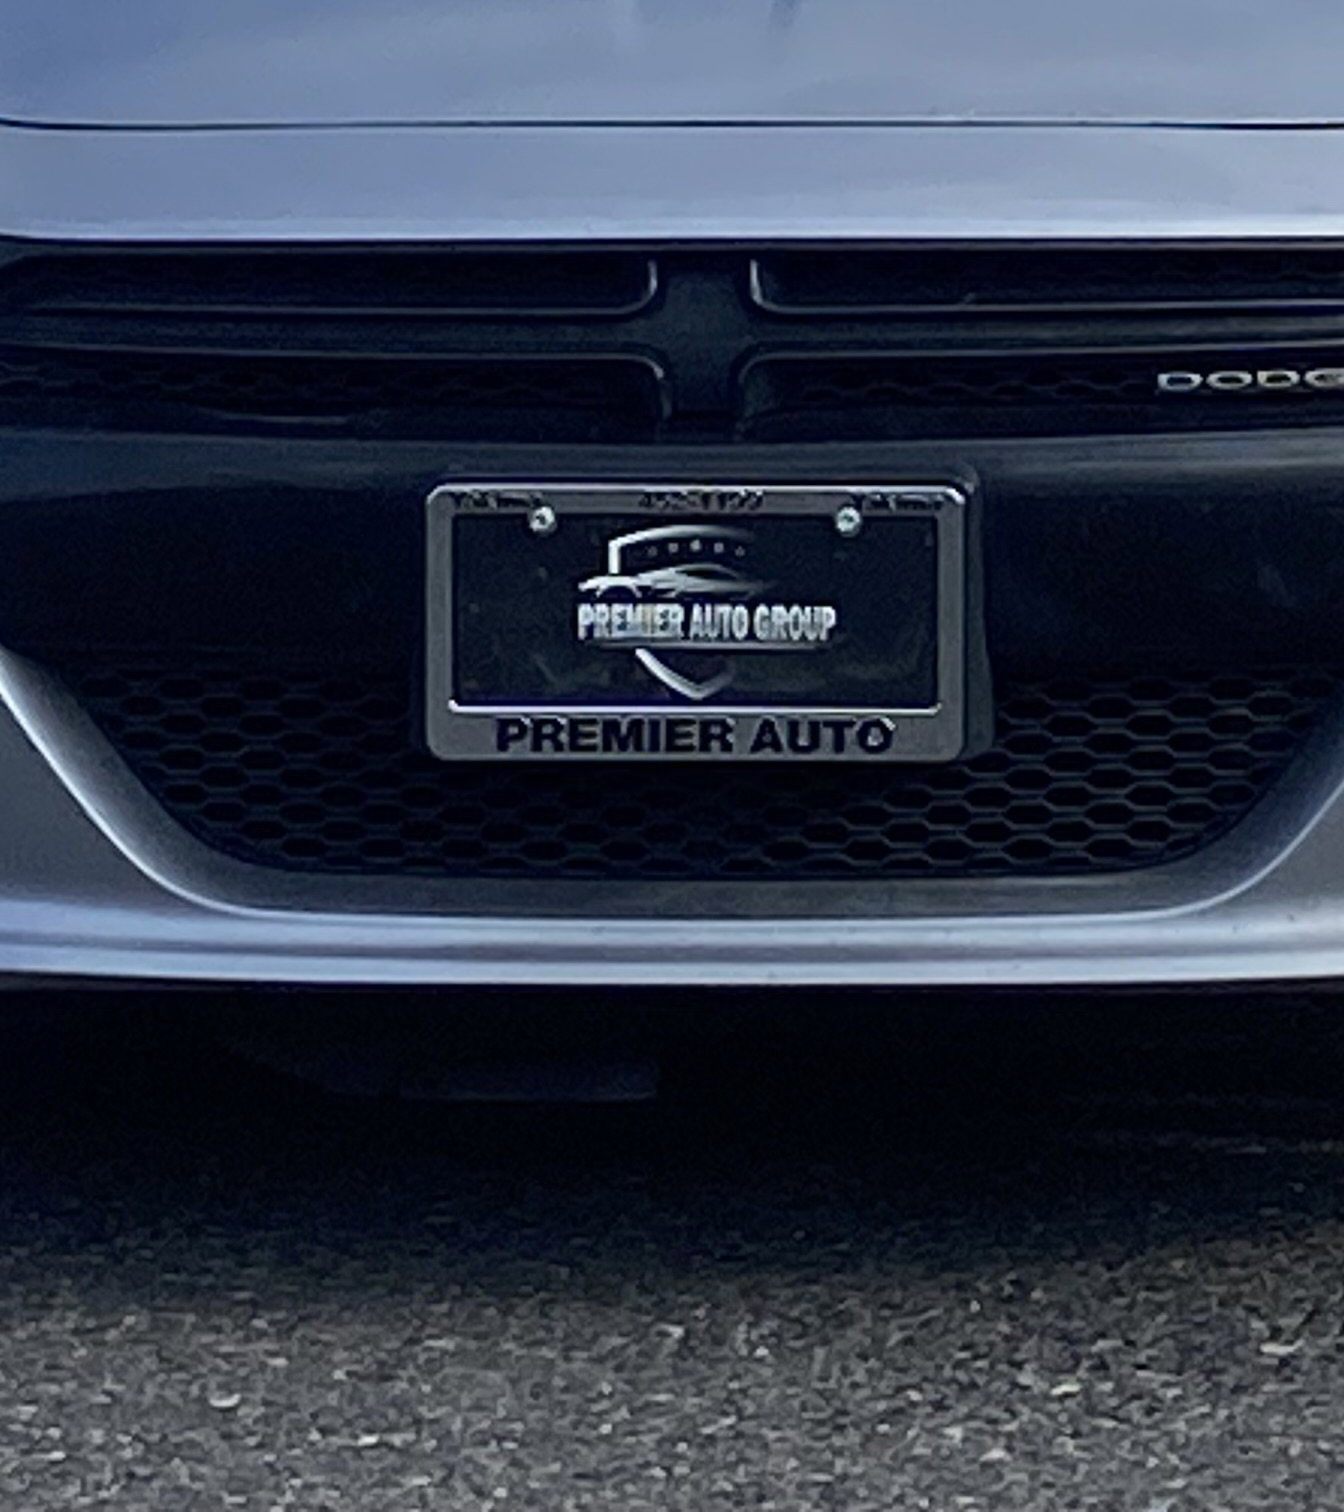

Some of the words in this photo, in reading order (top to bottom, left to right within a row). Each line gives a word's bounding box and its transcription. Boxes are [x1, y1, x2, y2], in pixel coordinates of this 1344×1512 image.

[577, 603, 683, 640] PREMIER
[689, 603, 749, 640] AUTO
[754, 604, 836, 641] GROUP
[496, 717, 734, 754] PREMIER
[750, 717, 894, 754] AUTO
